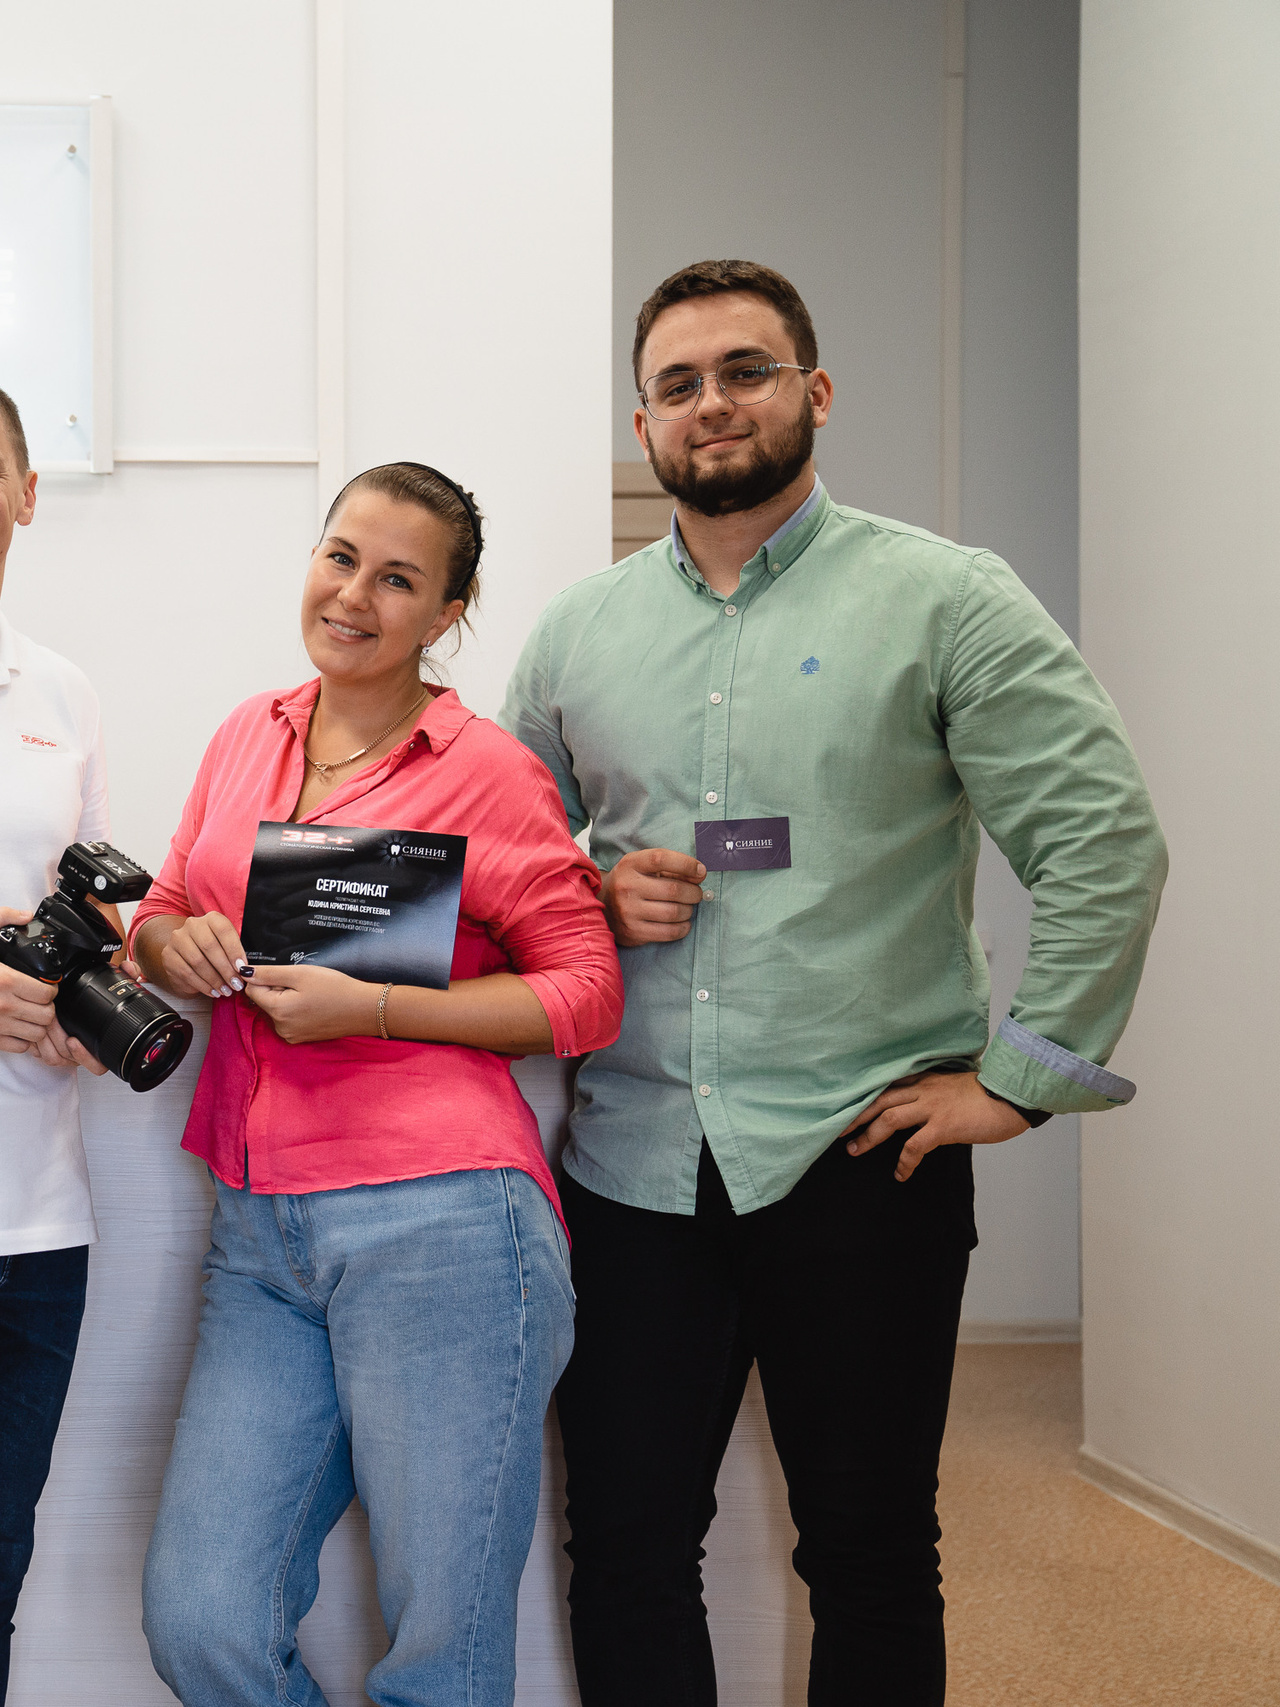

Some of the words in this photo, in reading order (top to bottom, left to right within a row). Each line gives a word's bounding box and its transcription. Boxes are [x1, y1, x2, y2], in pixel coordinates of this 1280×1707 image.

[281, 829, 353, 845] 32+
[735, 838, 773, 848] СИЯНИЕ
[402, 845, 447, 858] СИЯНИЕ
[316, 878, 389, 898] СЕРТИФИКАТ
[307, 899, 329, 909] ЮДИНА
[329, 903, 359, 913] КРИСТИНА
[359, 906, 391, 916] СЕРГЕЕВНА
[101, 944, 121, 953] Nikon
